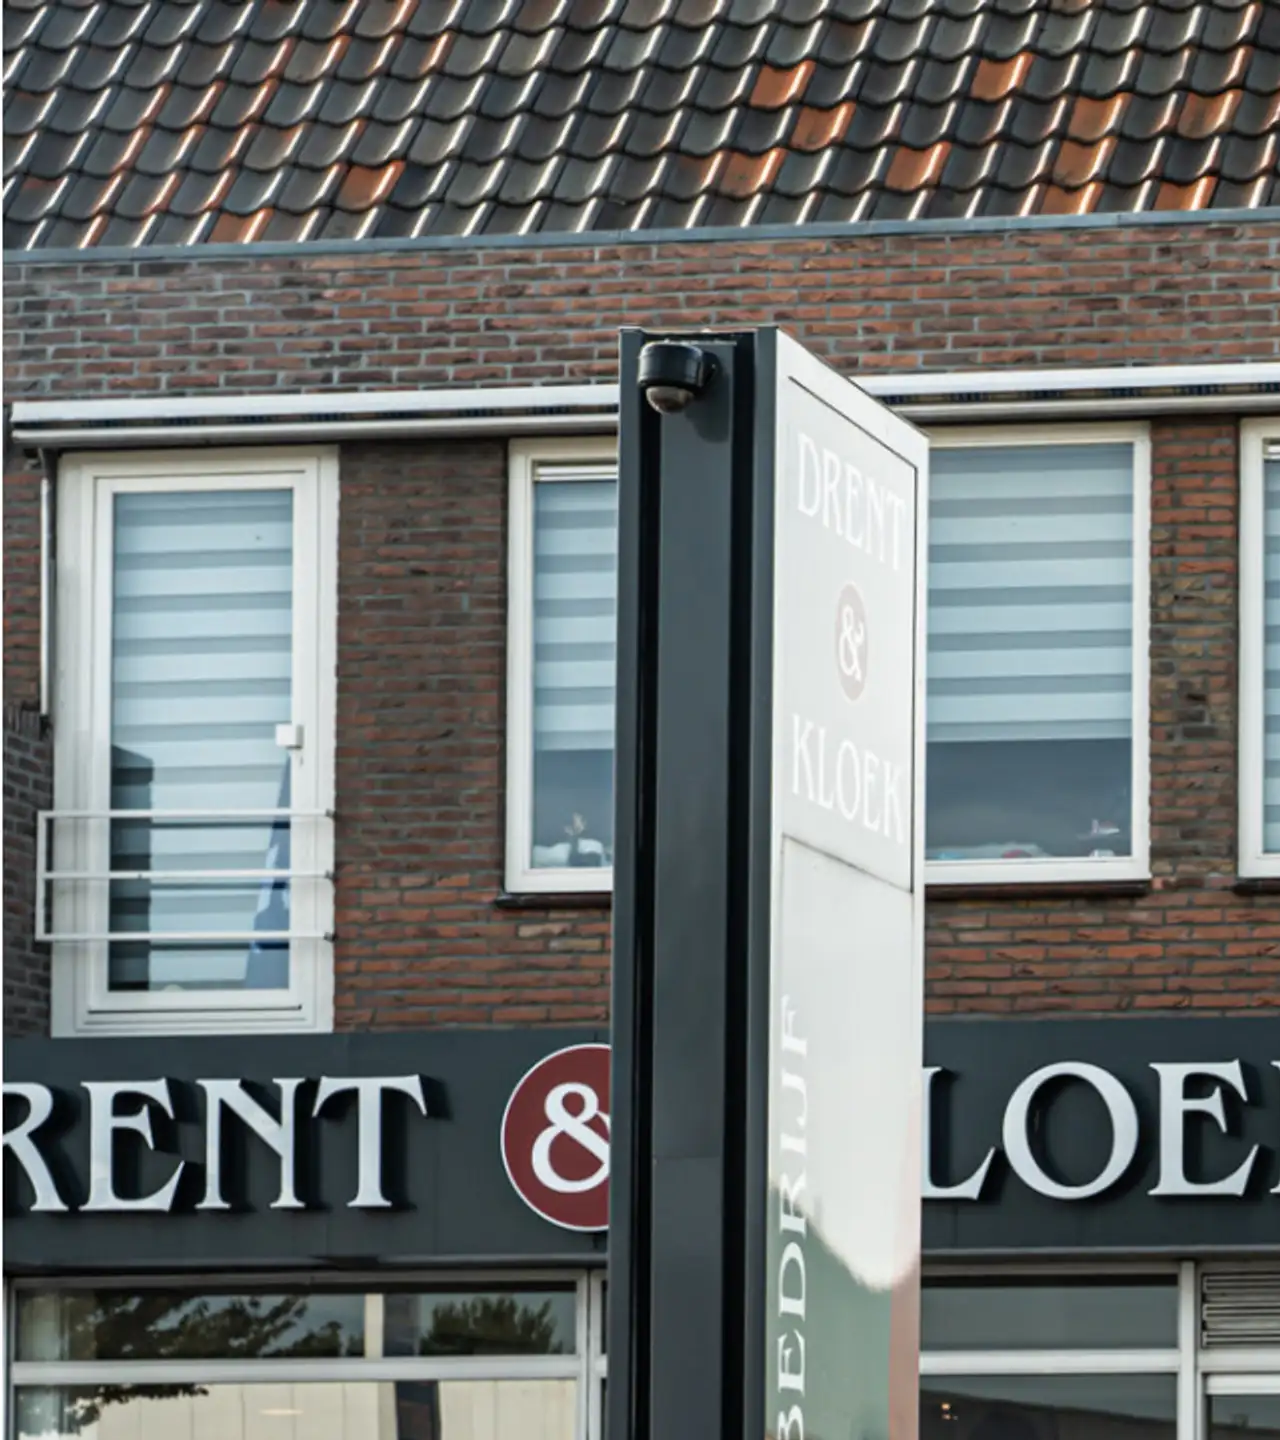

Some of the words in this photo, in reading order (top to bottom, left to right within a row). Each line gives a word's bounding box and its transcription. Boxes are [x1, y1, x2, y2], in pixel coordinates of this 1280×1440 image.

[796, 431, 907, 572] DRENT
[837, 604, 865, 683] &
[791, 711, 906, 846] KLOEK
[531, 1081, 611, 1194] &
